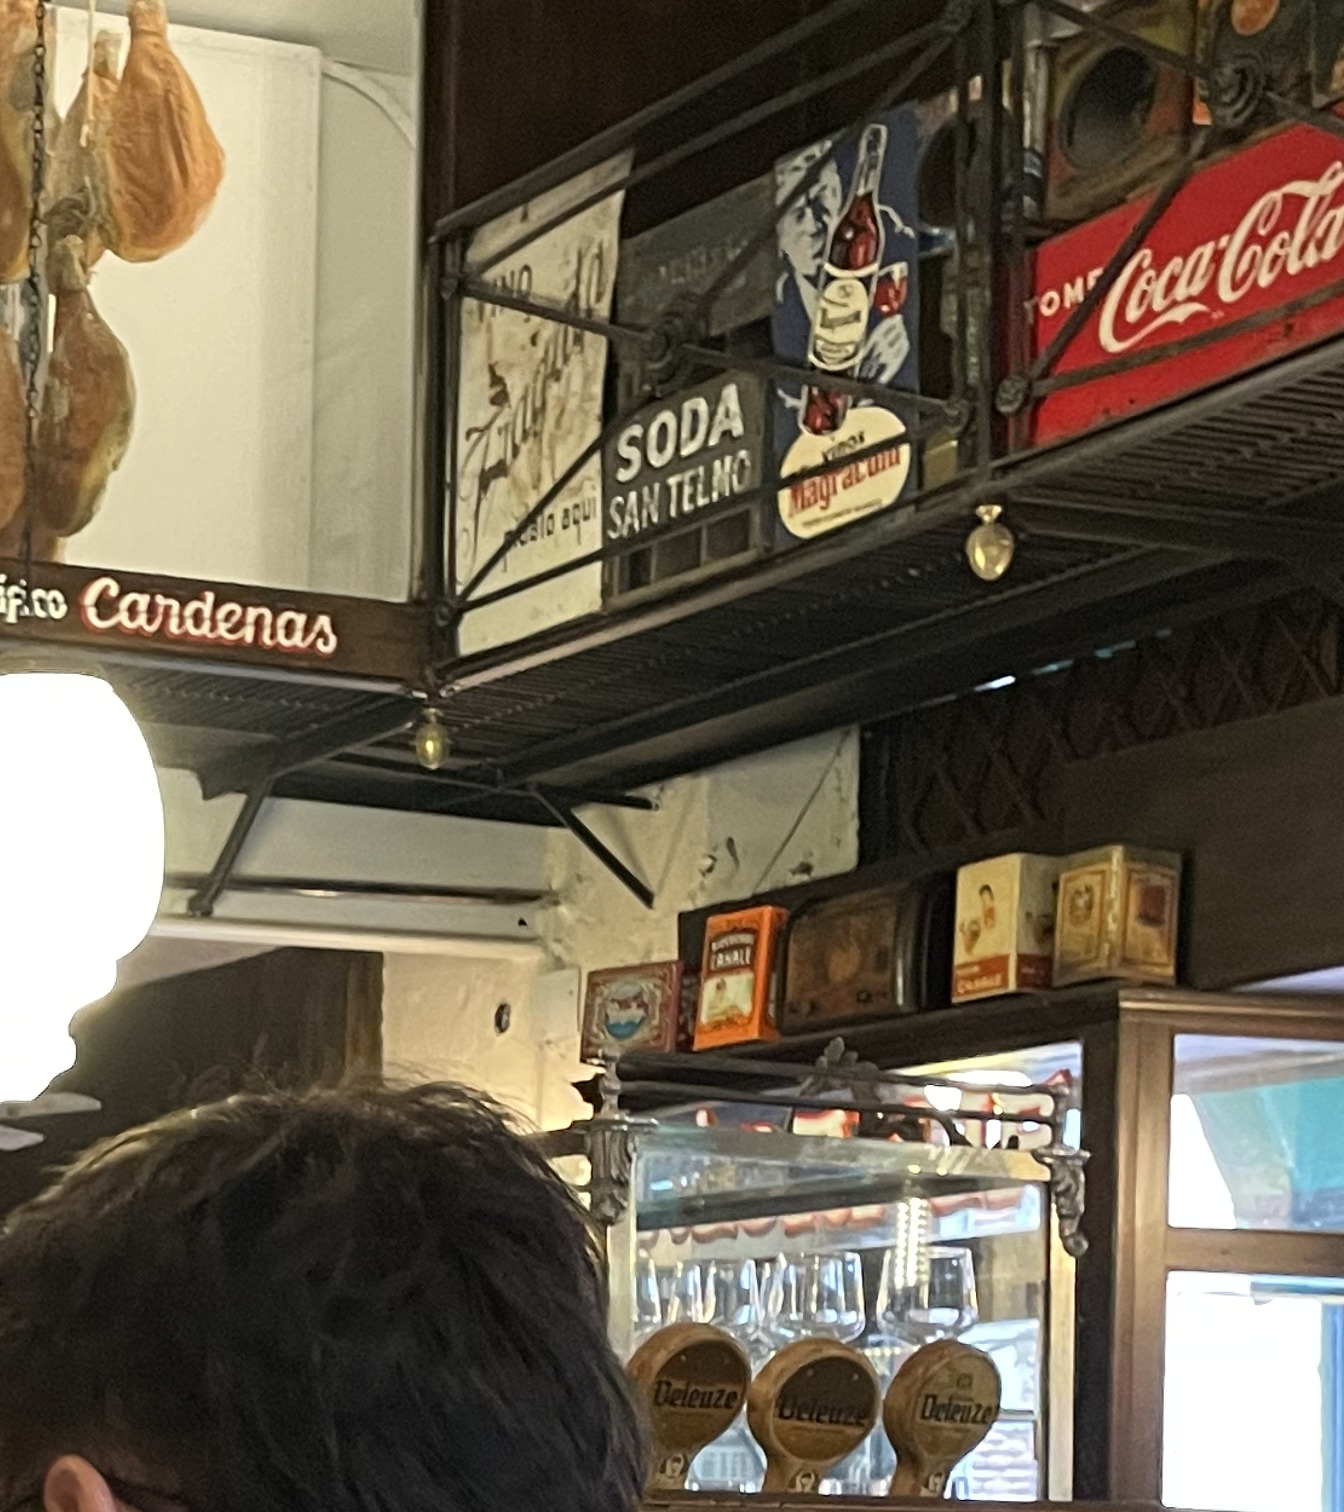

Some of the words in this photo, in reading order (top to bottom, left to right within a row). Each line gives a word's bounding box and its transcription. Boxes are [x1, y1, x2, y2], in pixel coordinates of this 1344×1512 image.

[615, 383, 745, 483] SODA
[607, 481, 661, 540] SAN
[666, 449, 752, 519] TELMO
[82, 576, 340, 656] Cardenas
[652, 1379, 740, 1412] Deleuze
[919, 1393, 996, 1427] Deleuze
